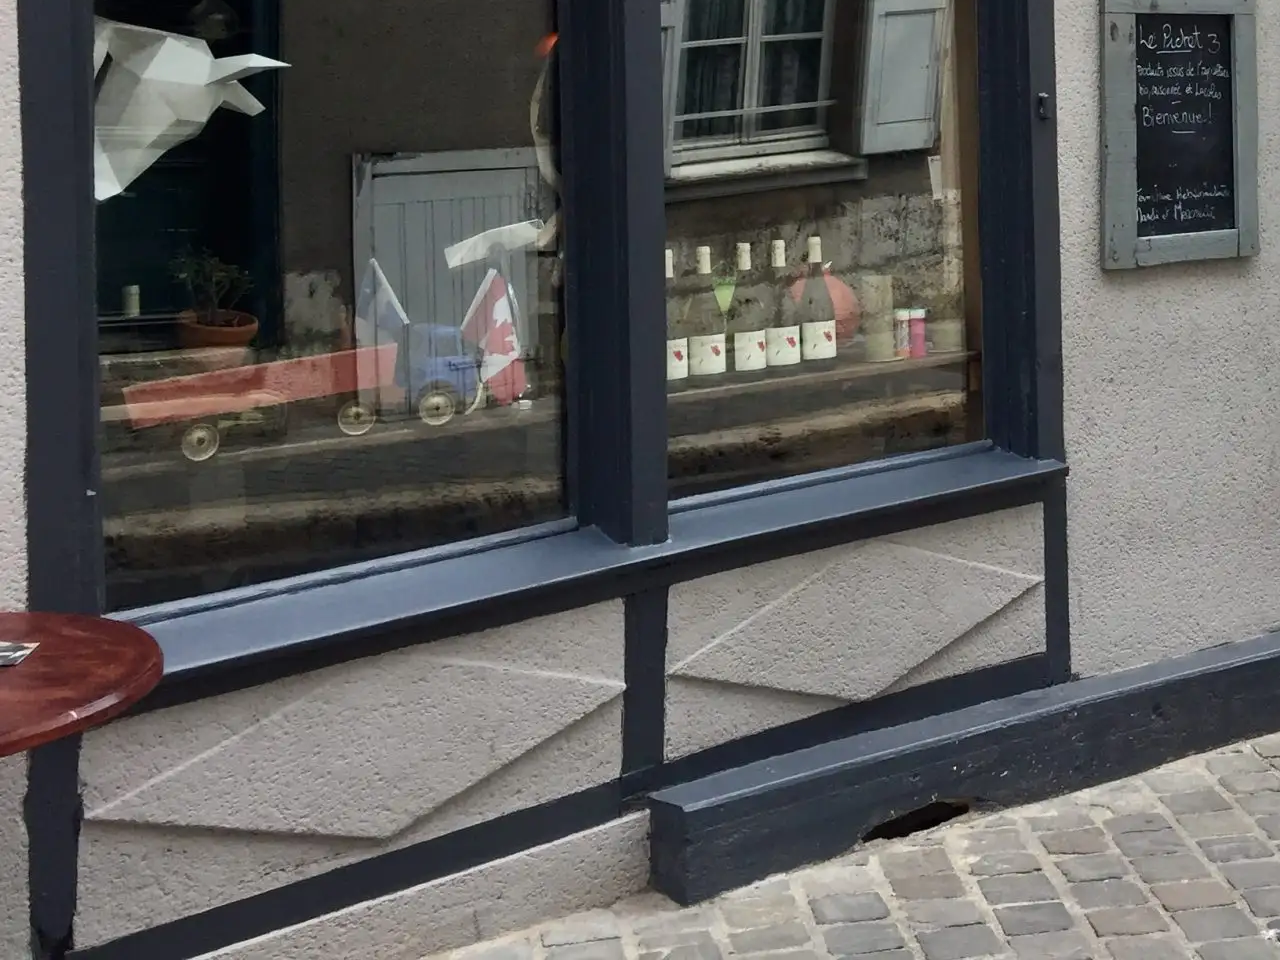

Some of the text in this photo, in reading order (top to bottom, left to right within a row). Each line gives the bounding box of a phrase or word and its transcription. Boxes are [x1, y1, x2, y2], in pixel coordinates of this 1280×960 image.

[1139, 23, 1221, 54] Le Pichet 3
